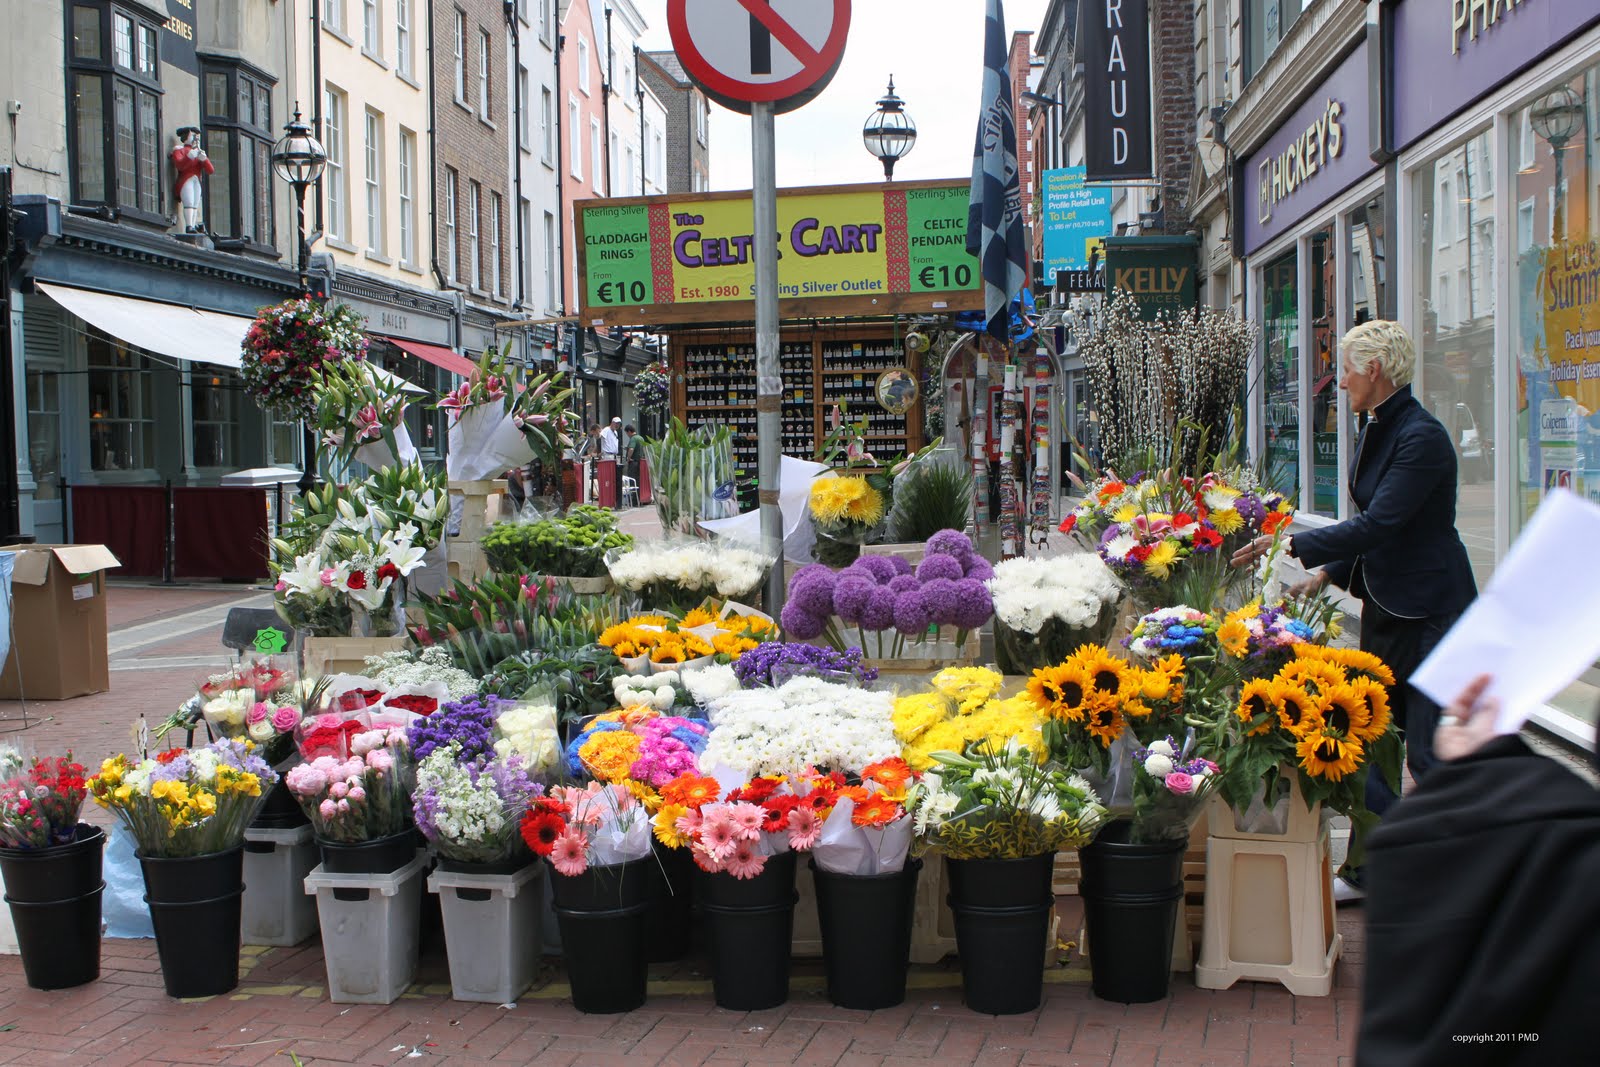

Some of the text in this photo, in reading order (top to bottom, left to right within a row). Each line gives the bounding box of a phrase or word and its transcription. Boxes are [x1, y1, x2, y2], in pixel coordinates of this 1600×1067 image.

[162, 16, 193, 40] LERIES
[1272, 97, 1342, 205] HICKEY'S
[909, 187, 970, 200] Sterling Silve
[1048, 193, 1068, 201] Prime
[1076, 190, 1092, 199] High
[1048, 197, 1105, 210] Profile Retail Unit
[586, 206, 645, 218] Sterling Silver
[1049, 211, 1076, 221] To Let
[673, 213, 704, 226] The
[924, 218, 964, 230] CELTIC
[585, 233, 648, 245] CLADDAGH
[790, 217, 883, 257] CART
[600, 249, 634, 260] RINGS
[913, 256, 933, 264] From
[593, 272, 612, 280] From
[918, 264, 971, 288] €10
[1114, 267, 1189, 293] KELLY
[597, 280, 646, 303] €10
[681, 287, 704, 298] Est.
[707, 285, 740, 297] 1980
[802, 281, 838, 293] Silver
[841, 278, 882, 291] Outlet
[382, 312, 408, 330] BAILEY
[1565, 327, 1584, 351] Pack
[1550, 359, 1581, 383] Holiday
